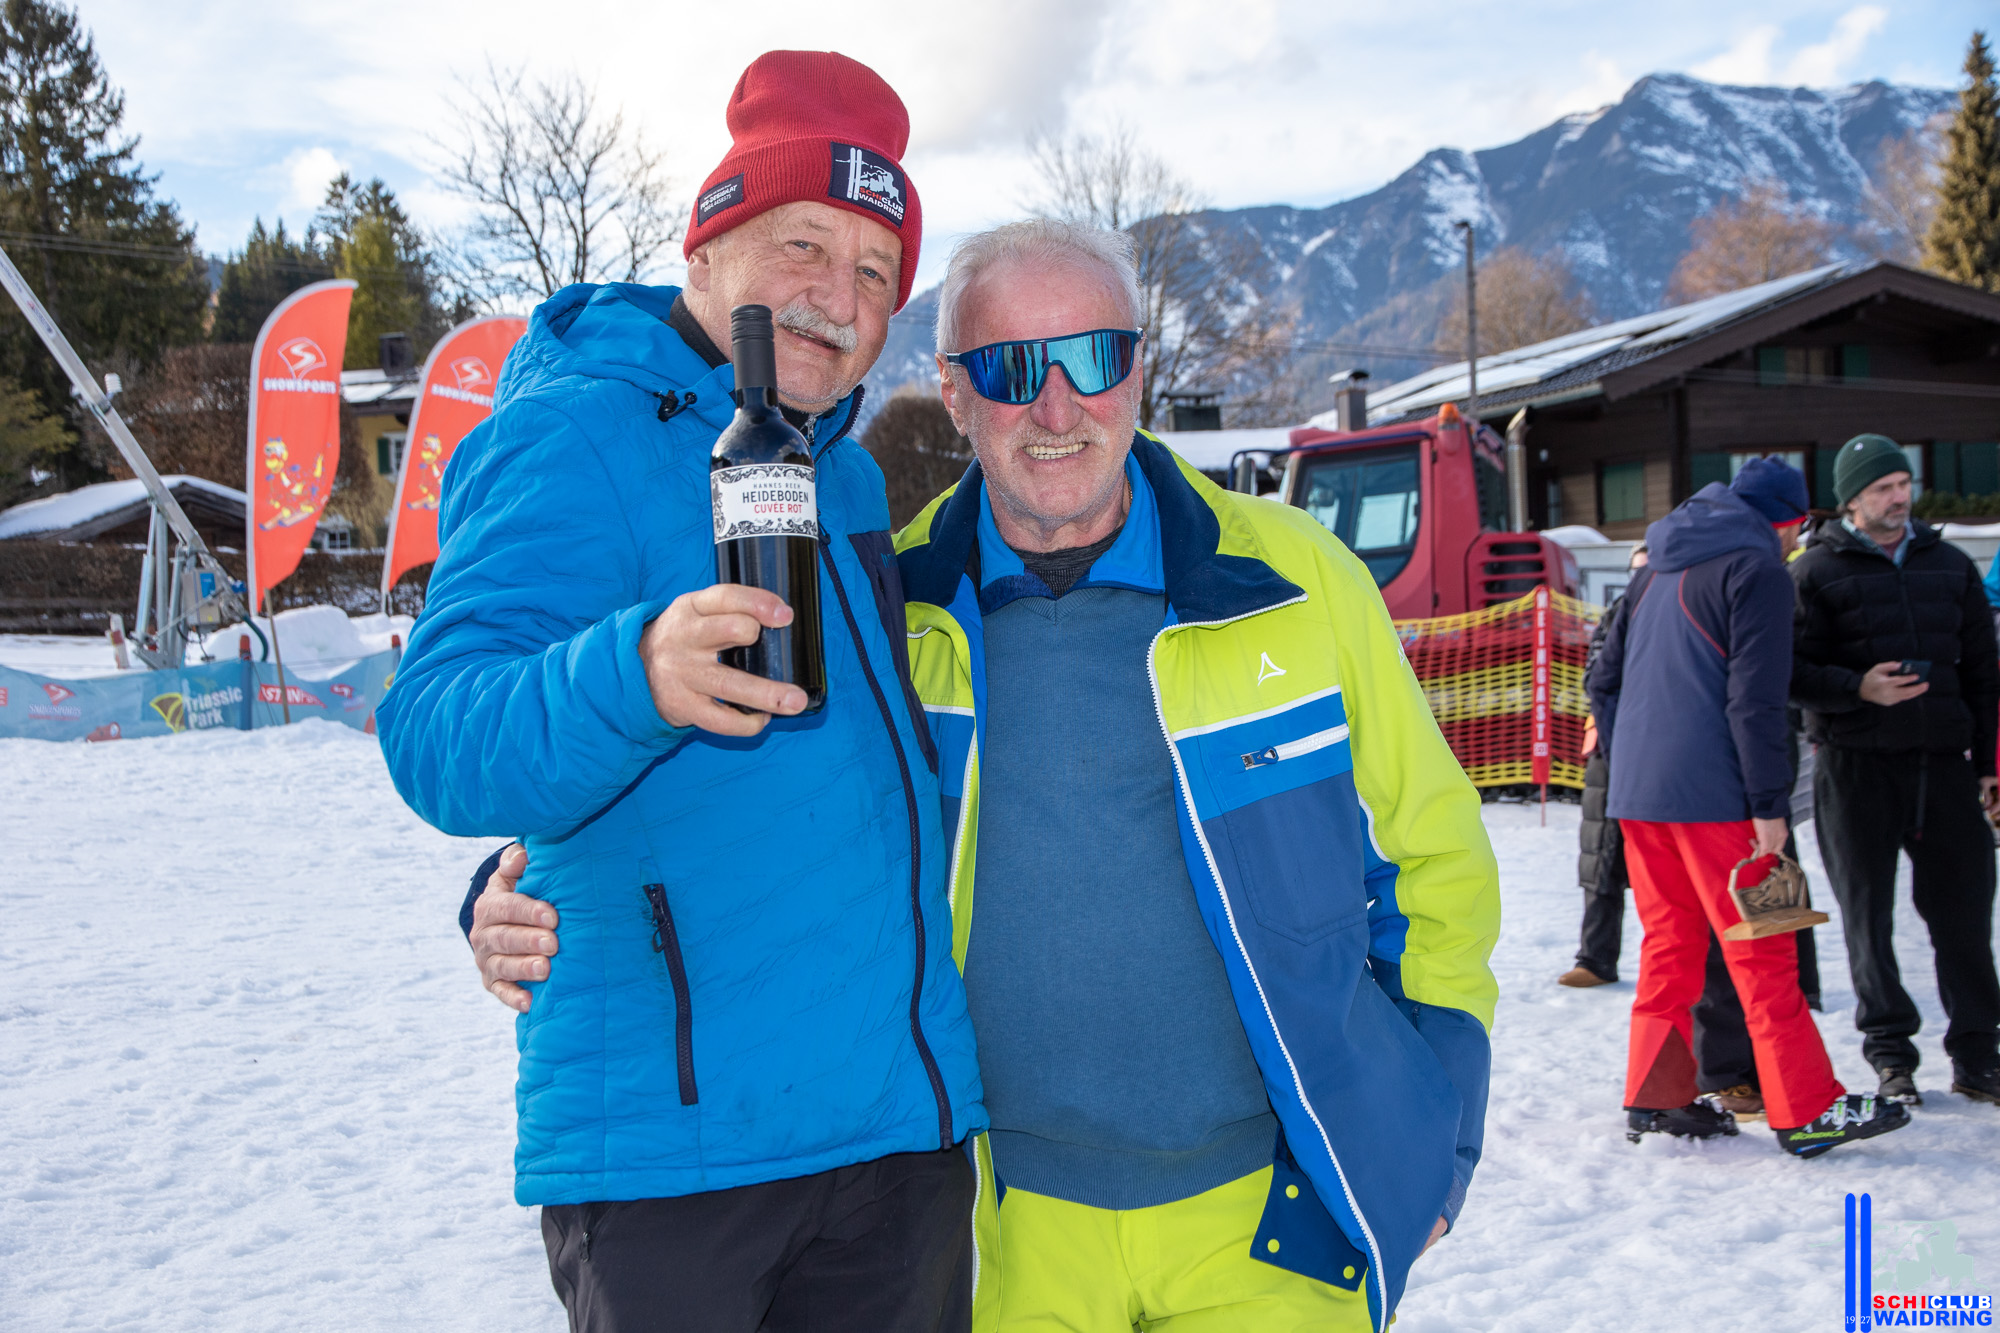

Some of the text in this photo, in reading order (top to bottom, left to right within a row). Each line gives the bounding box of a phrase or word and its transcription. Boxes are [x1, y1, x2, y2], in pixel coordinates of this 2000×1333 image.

[859, 186, 904, 214] SCHICLUB
[859, 193, 903, 220] WAIDRING
[263, 377, 336, 394] SNOWSPORTS
[742, 490, 809, 504] HEIDEBODEN
[754, 502, 802, 514] CUVÉE ROT
[1535, 590, 1548, 740] WEINGAST
[188, 707, 224, 730] Park
